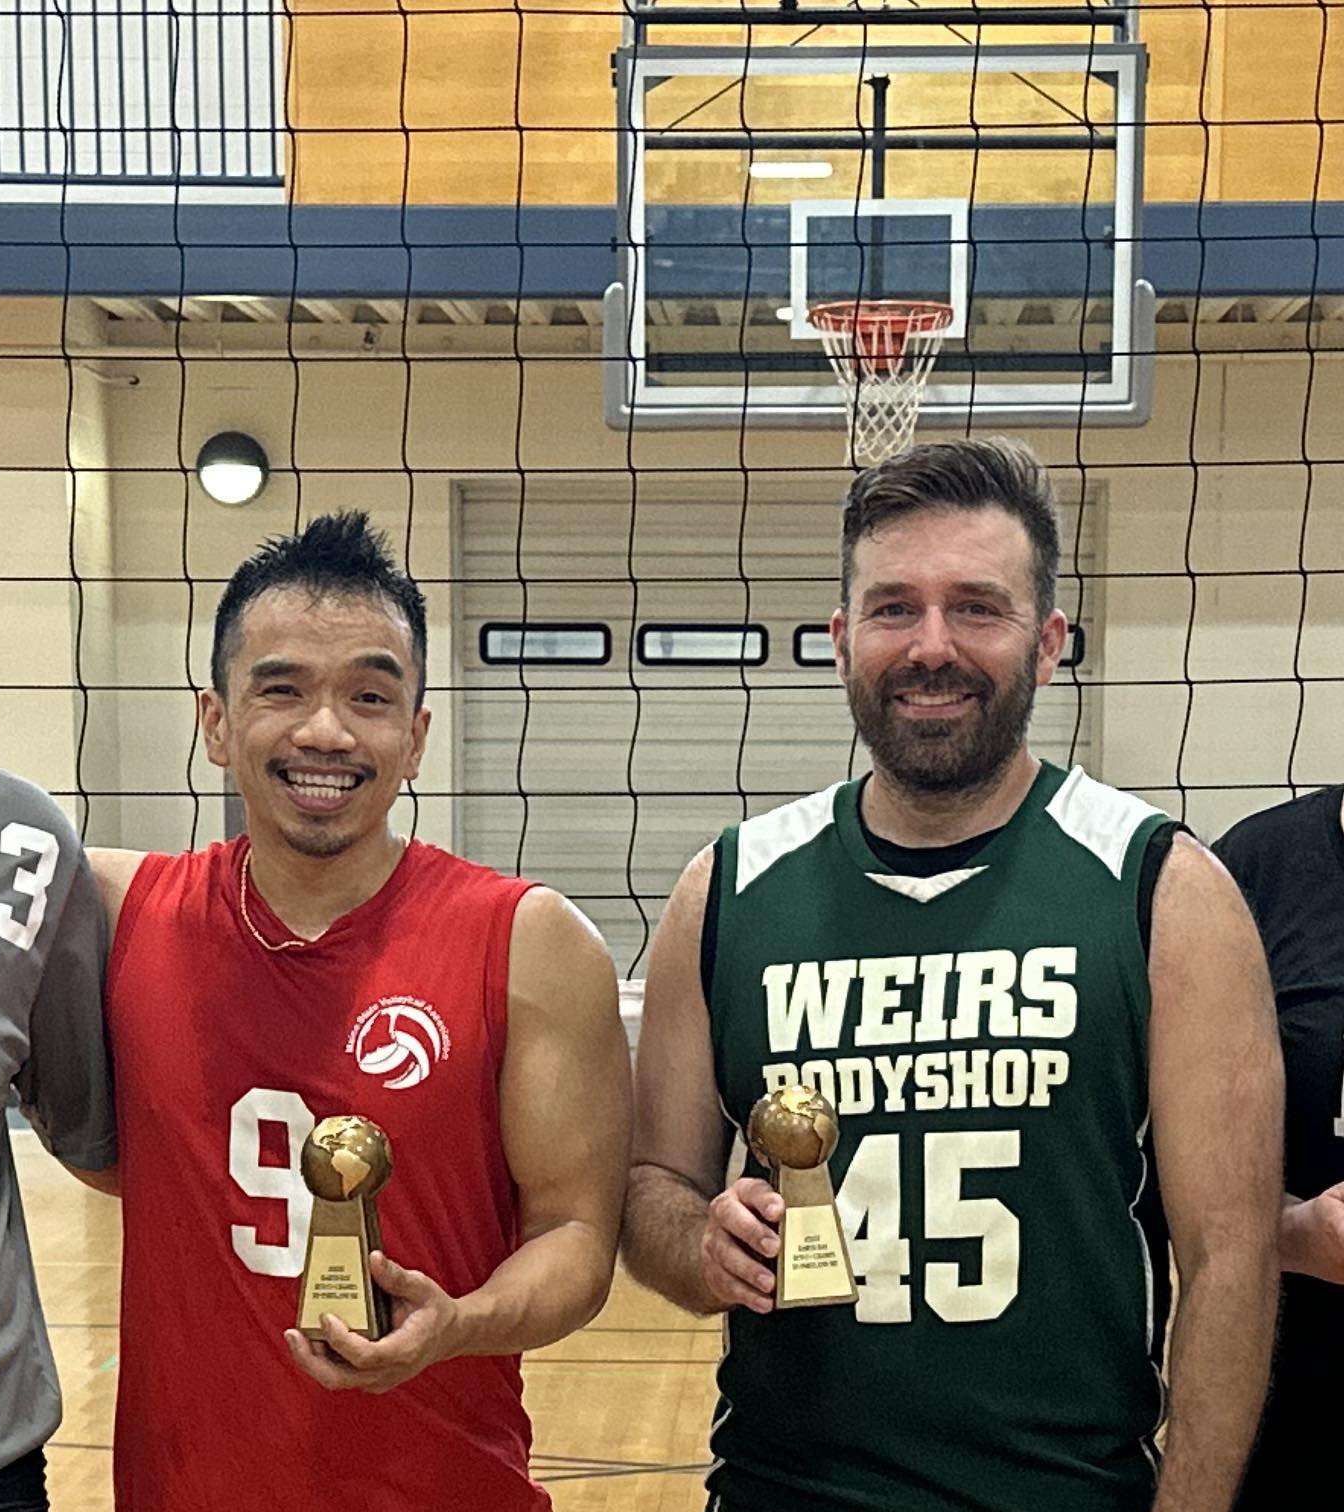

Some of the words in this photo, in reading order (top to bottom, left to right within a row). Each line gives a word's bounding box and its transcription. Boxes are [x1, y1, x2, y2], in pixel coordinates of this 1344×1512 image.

[762, 947, 1078, 1053] WEIRS
[229, 1087, 315, 1278] 9
[834, 1130, 1021, 1322] 45
